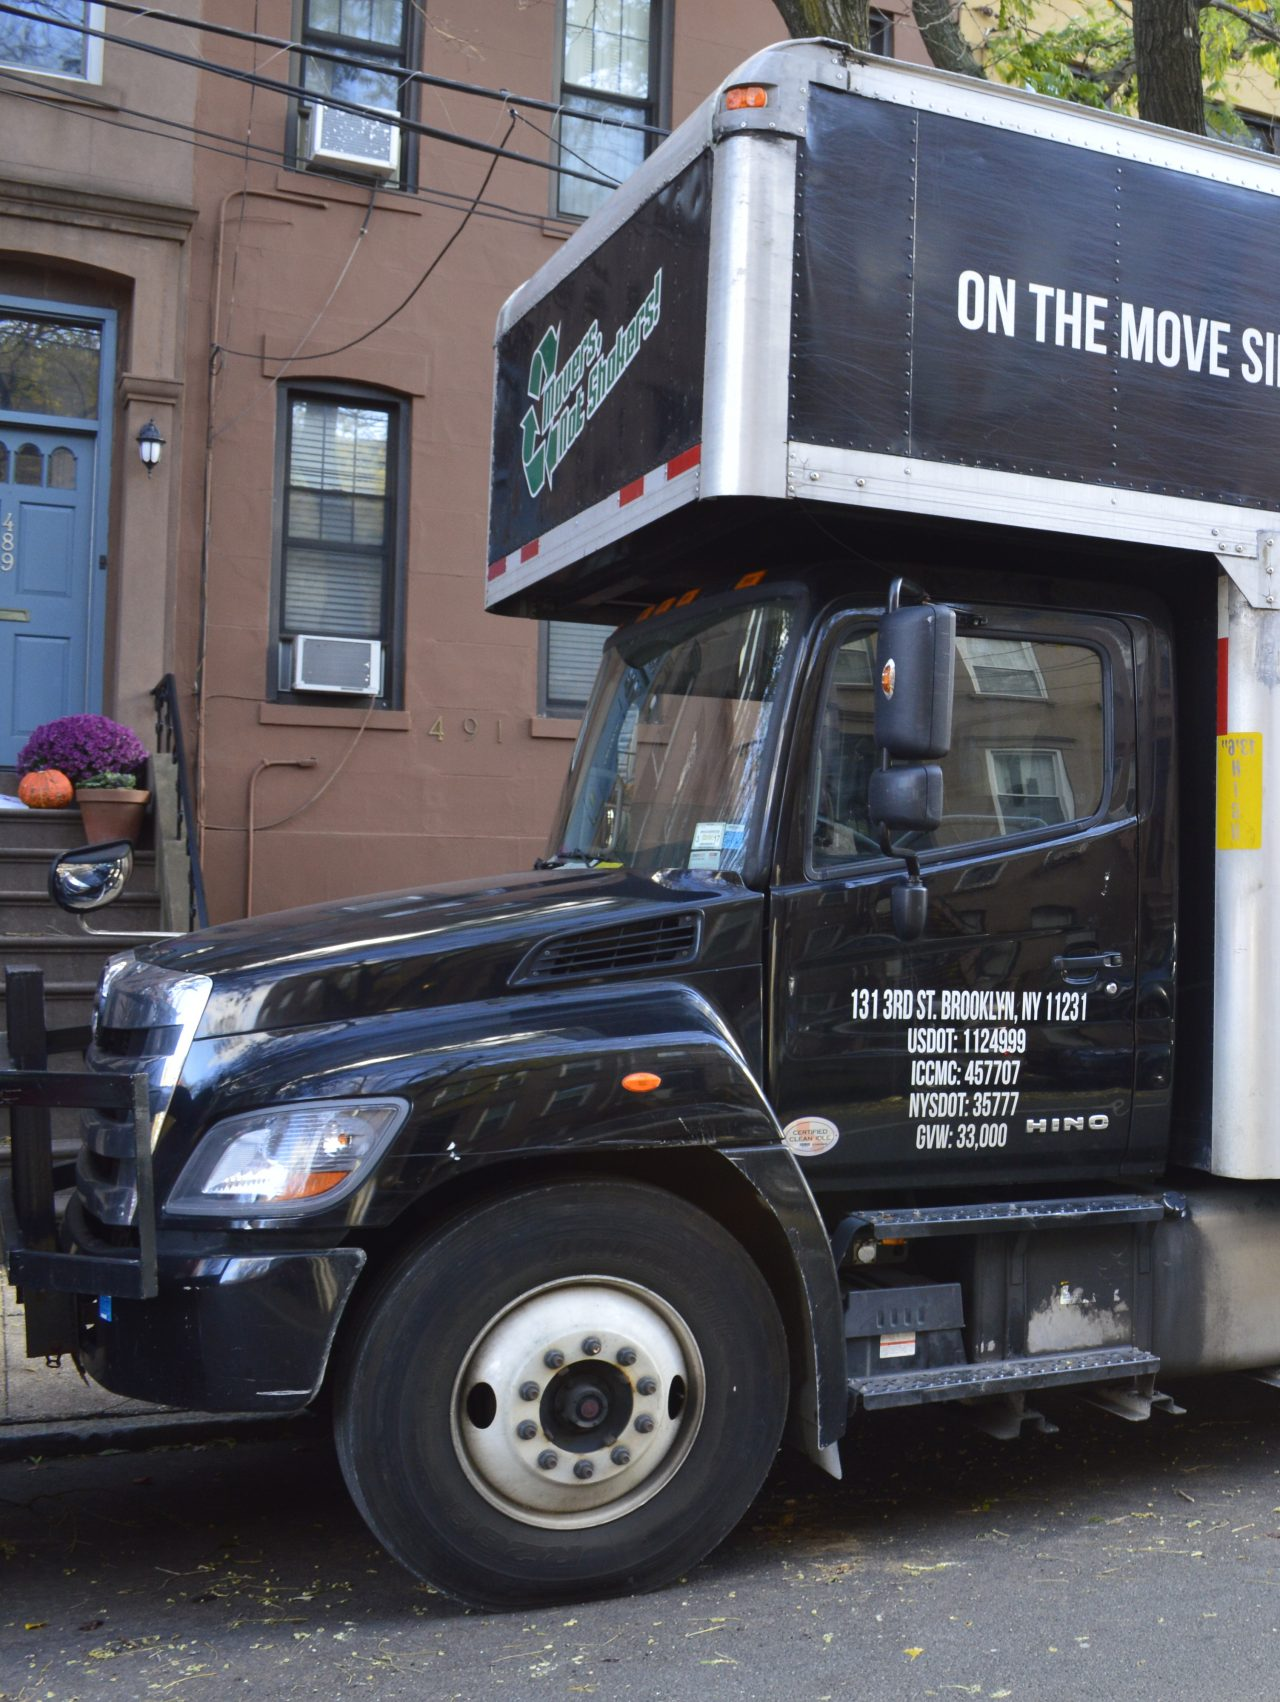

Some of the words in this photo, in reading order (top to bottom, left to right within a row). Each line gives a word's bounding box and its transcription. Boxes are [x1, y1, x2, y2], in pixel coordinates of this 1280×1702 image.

[958, 270, 1015, 337] ON
[1029, 283, 1108, 355] THE
[1120, 302, 1230, 378] MOVE
[586, 267, 662, 420] Shakers!
[2, 512, 14, 571] 489
[427, 715, 503, 744] 491
[851, 988, 879, 1020] 131
[882, 989, 914, 1020] 3RD
[916, 990, 937, 1020] ST.
[941, 990, 1018, 1024] BROOKLYN,
[1021, 992, 1042, 1021] NY
[1046, 992, 1088, 1021] 11231
[907, 1028, 958, 1054] USDOT:
[963, 1028, 1027, 1054] 1124999
[911, 1060, 961, 1086] ICCMC:
[964, 1060, 1021, 1086] 457707
[908, 1092, 969, 1118] NYSDOT:
[972, 1091, 1019, 1117] 35777
[916, 1124, 953, 1149] GVW:
[956, 1123, 1008, 1151] 33,000
[1026, 1114, 1110, 1133] HINO
